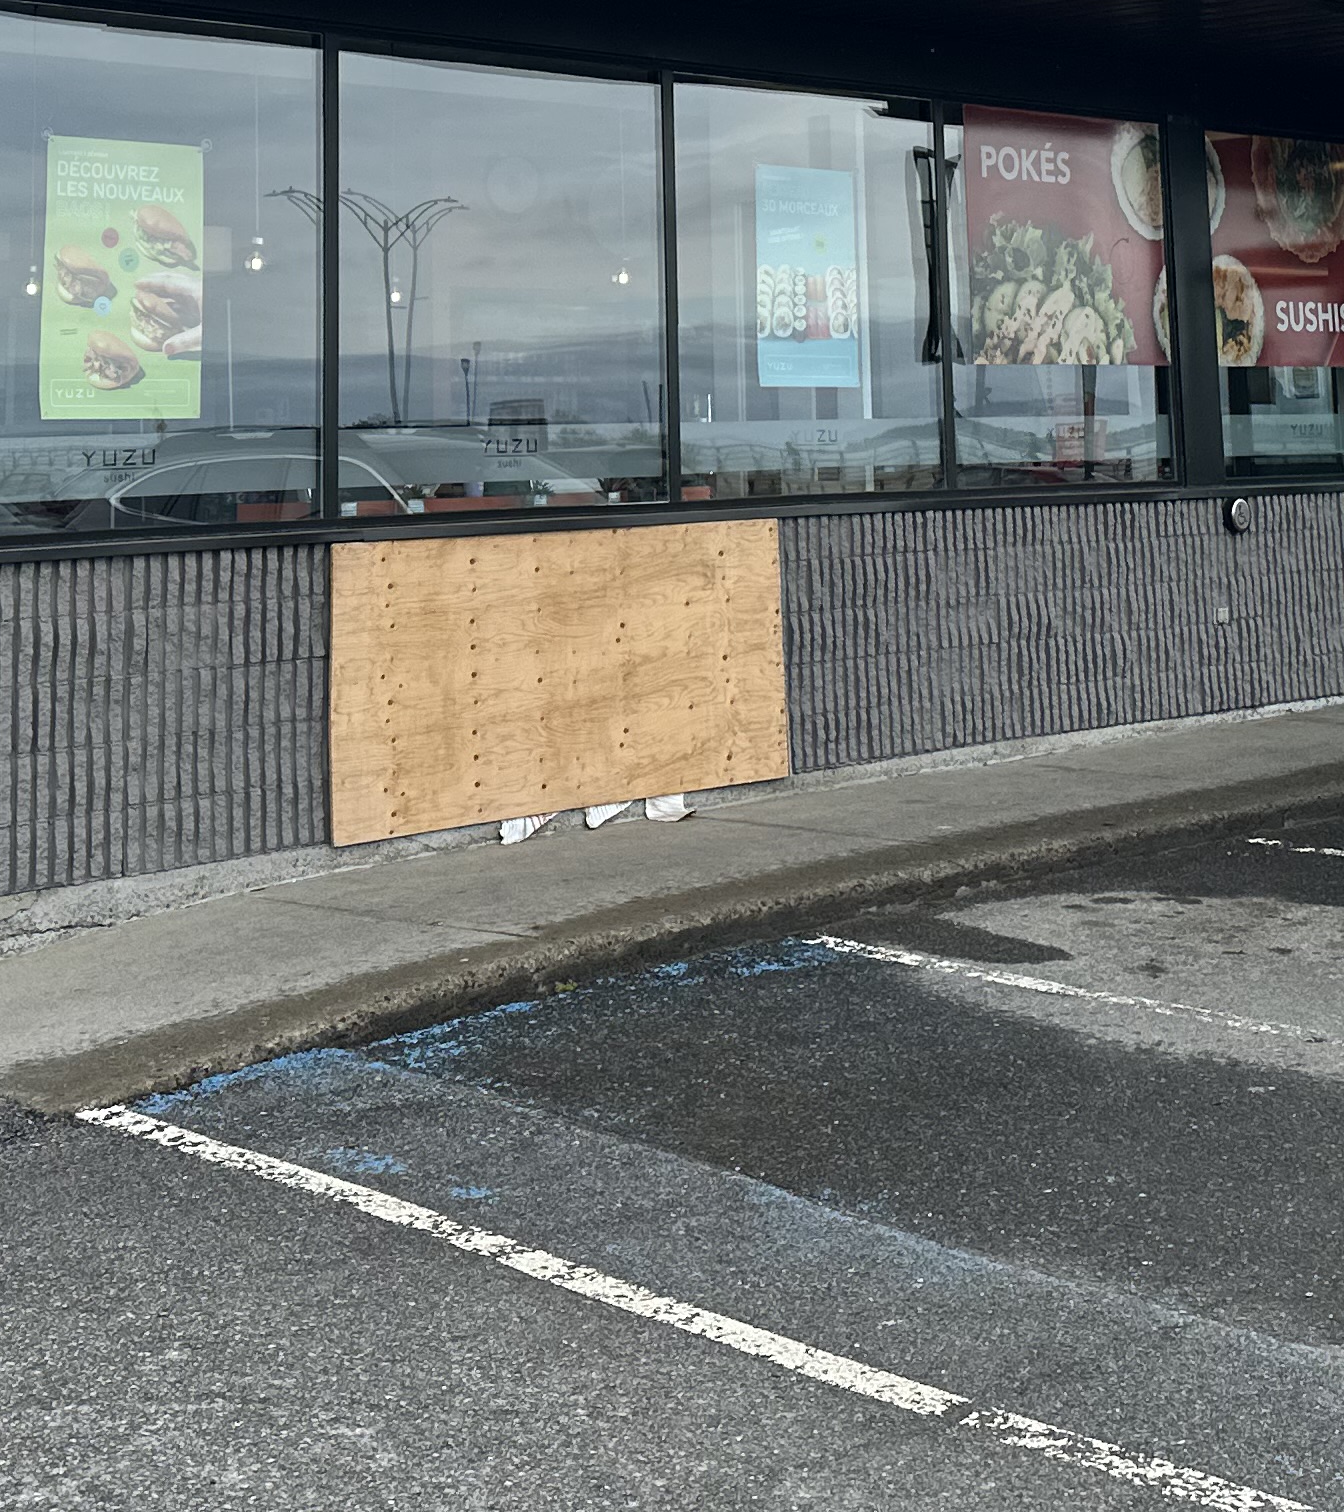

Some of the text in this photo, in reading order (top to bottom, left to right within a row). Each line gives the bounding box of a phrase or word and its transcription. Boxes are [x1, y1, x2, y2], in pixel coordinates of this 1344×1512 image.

[57, 155, 160, 182] DÉCOUVREZ
[980, 142, 1071, 185] POKÉS
[56, 180, 185, 203] LES NOUVEAUX
[778, 199, 839, 217] MORCEAUX
[56, 389, 96, 399] YUZU
[480, 438, 537, 453] YUZU
[82, 448, 156, 467] YUZU
